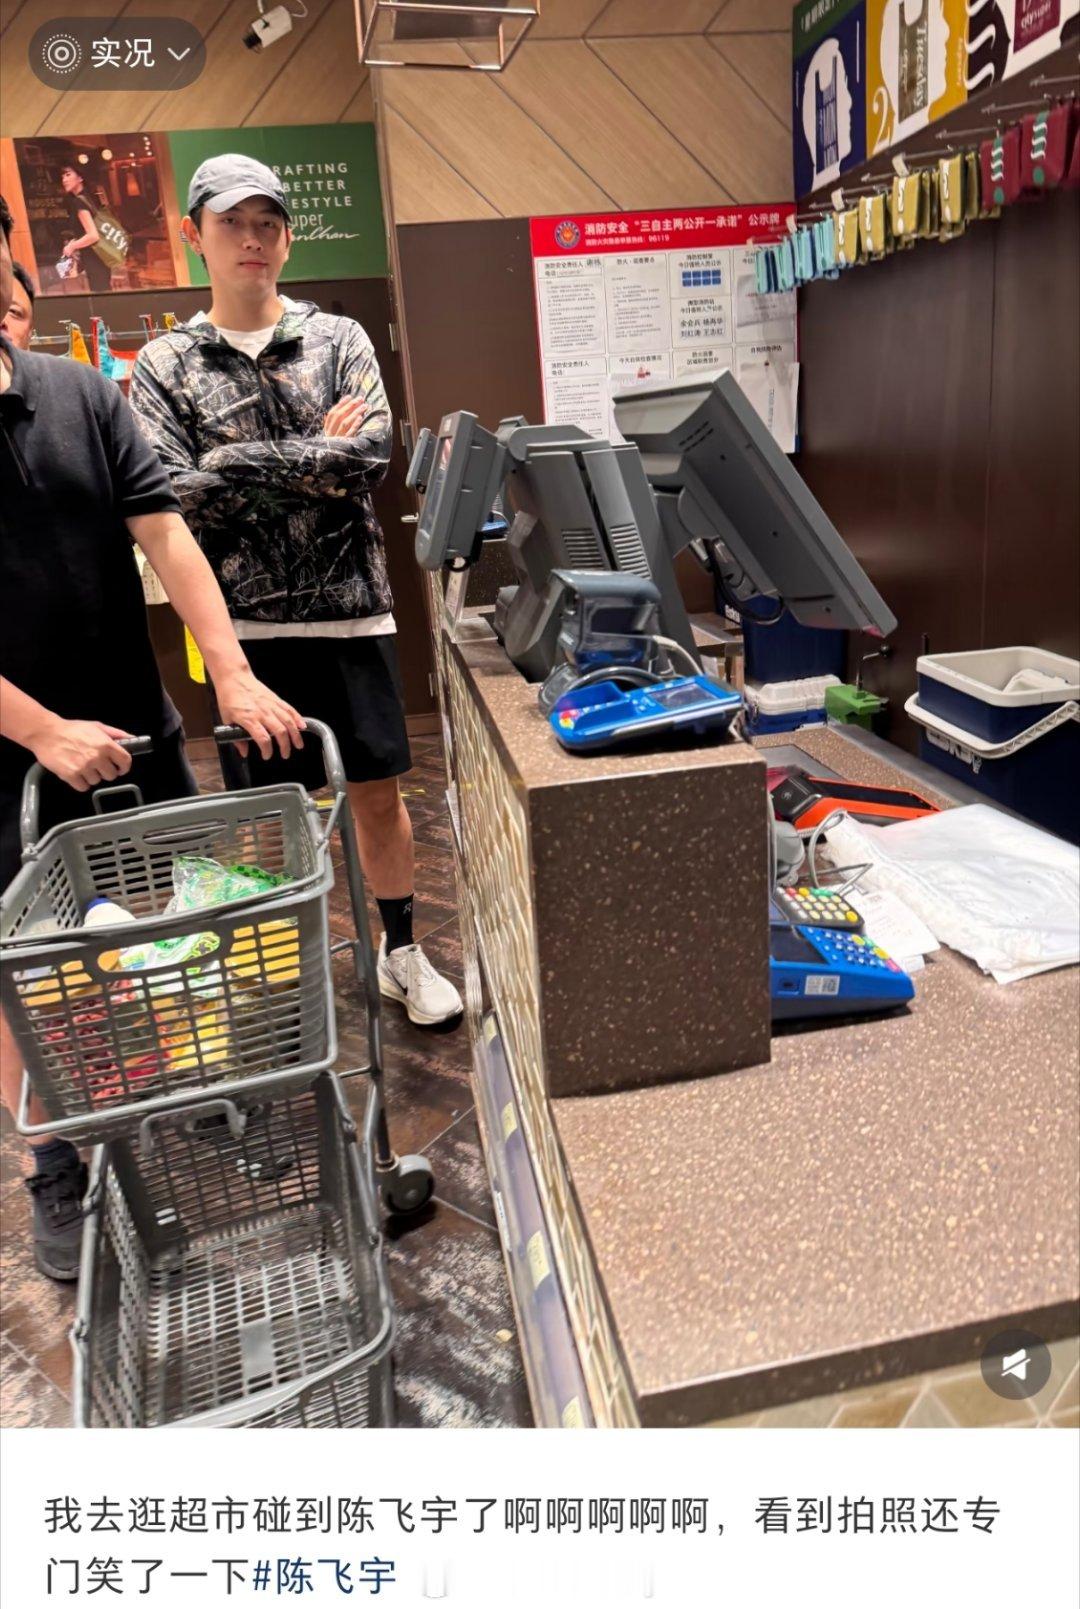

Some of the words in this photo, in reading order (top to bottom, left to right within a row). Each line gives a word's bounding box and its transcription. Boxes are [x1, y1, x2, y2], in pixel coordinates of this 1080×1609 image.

[272, 163, 348, 176] RAFTING
[282, 180, 346, 192] BETTER
[291, 196, 352, 209] ESTYLE
[290, 213, 324, 231] uper
